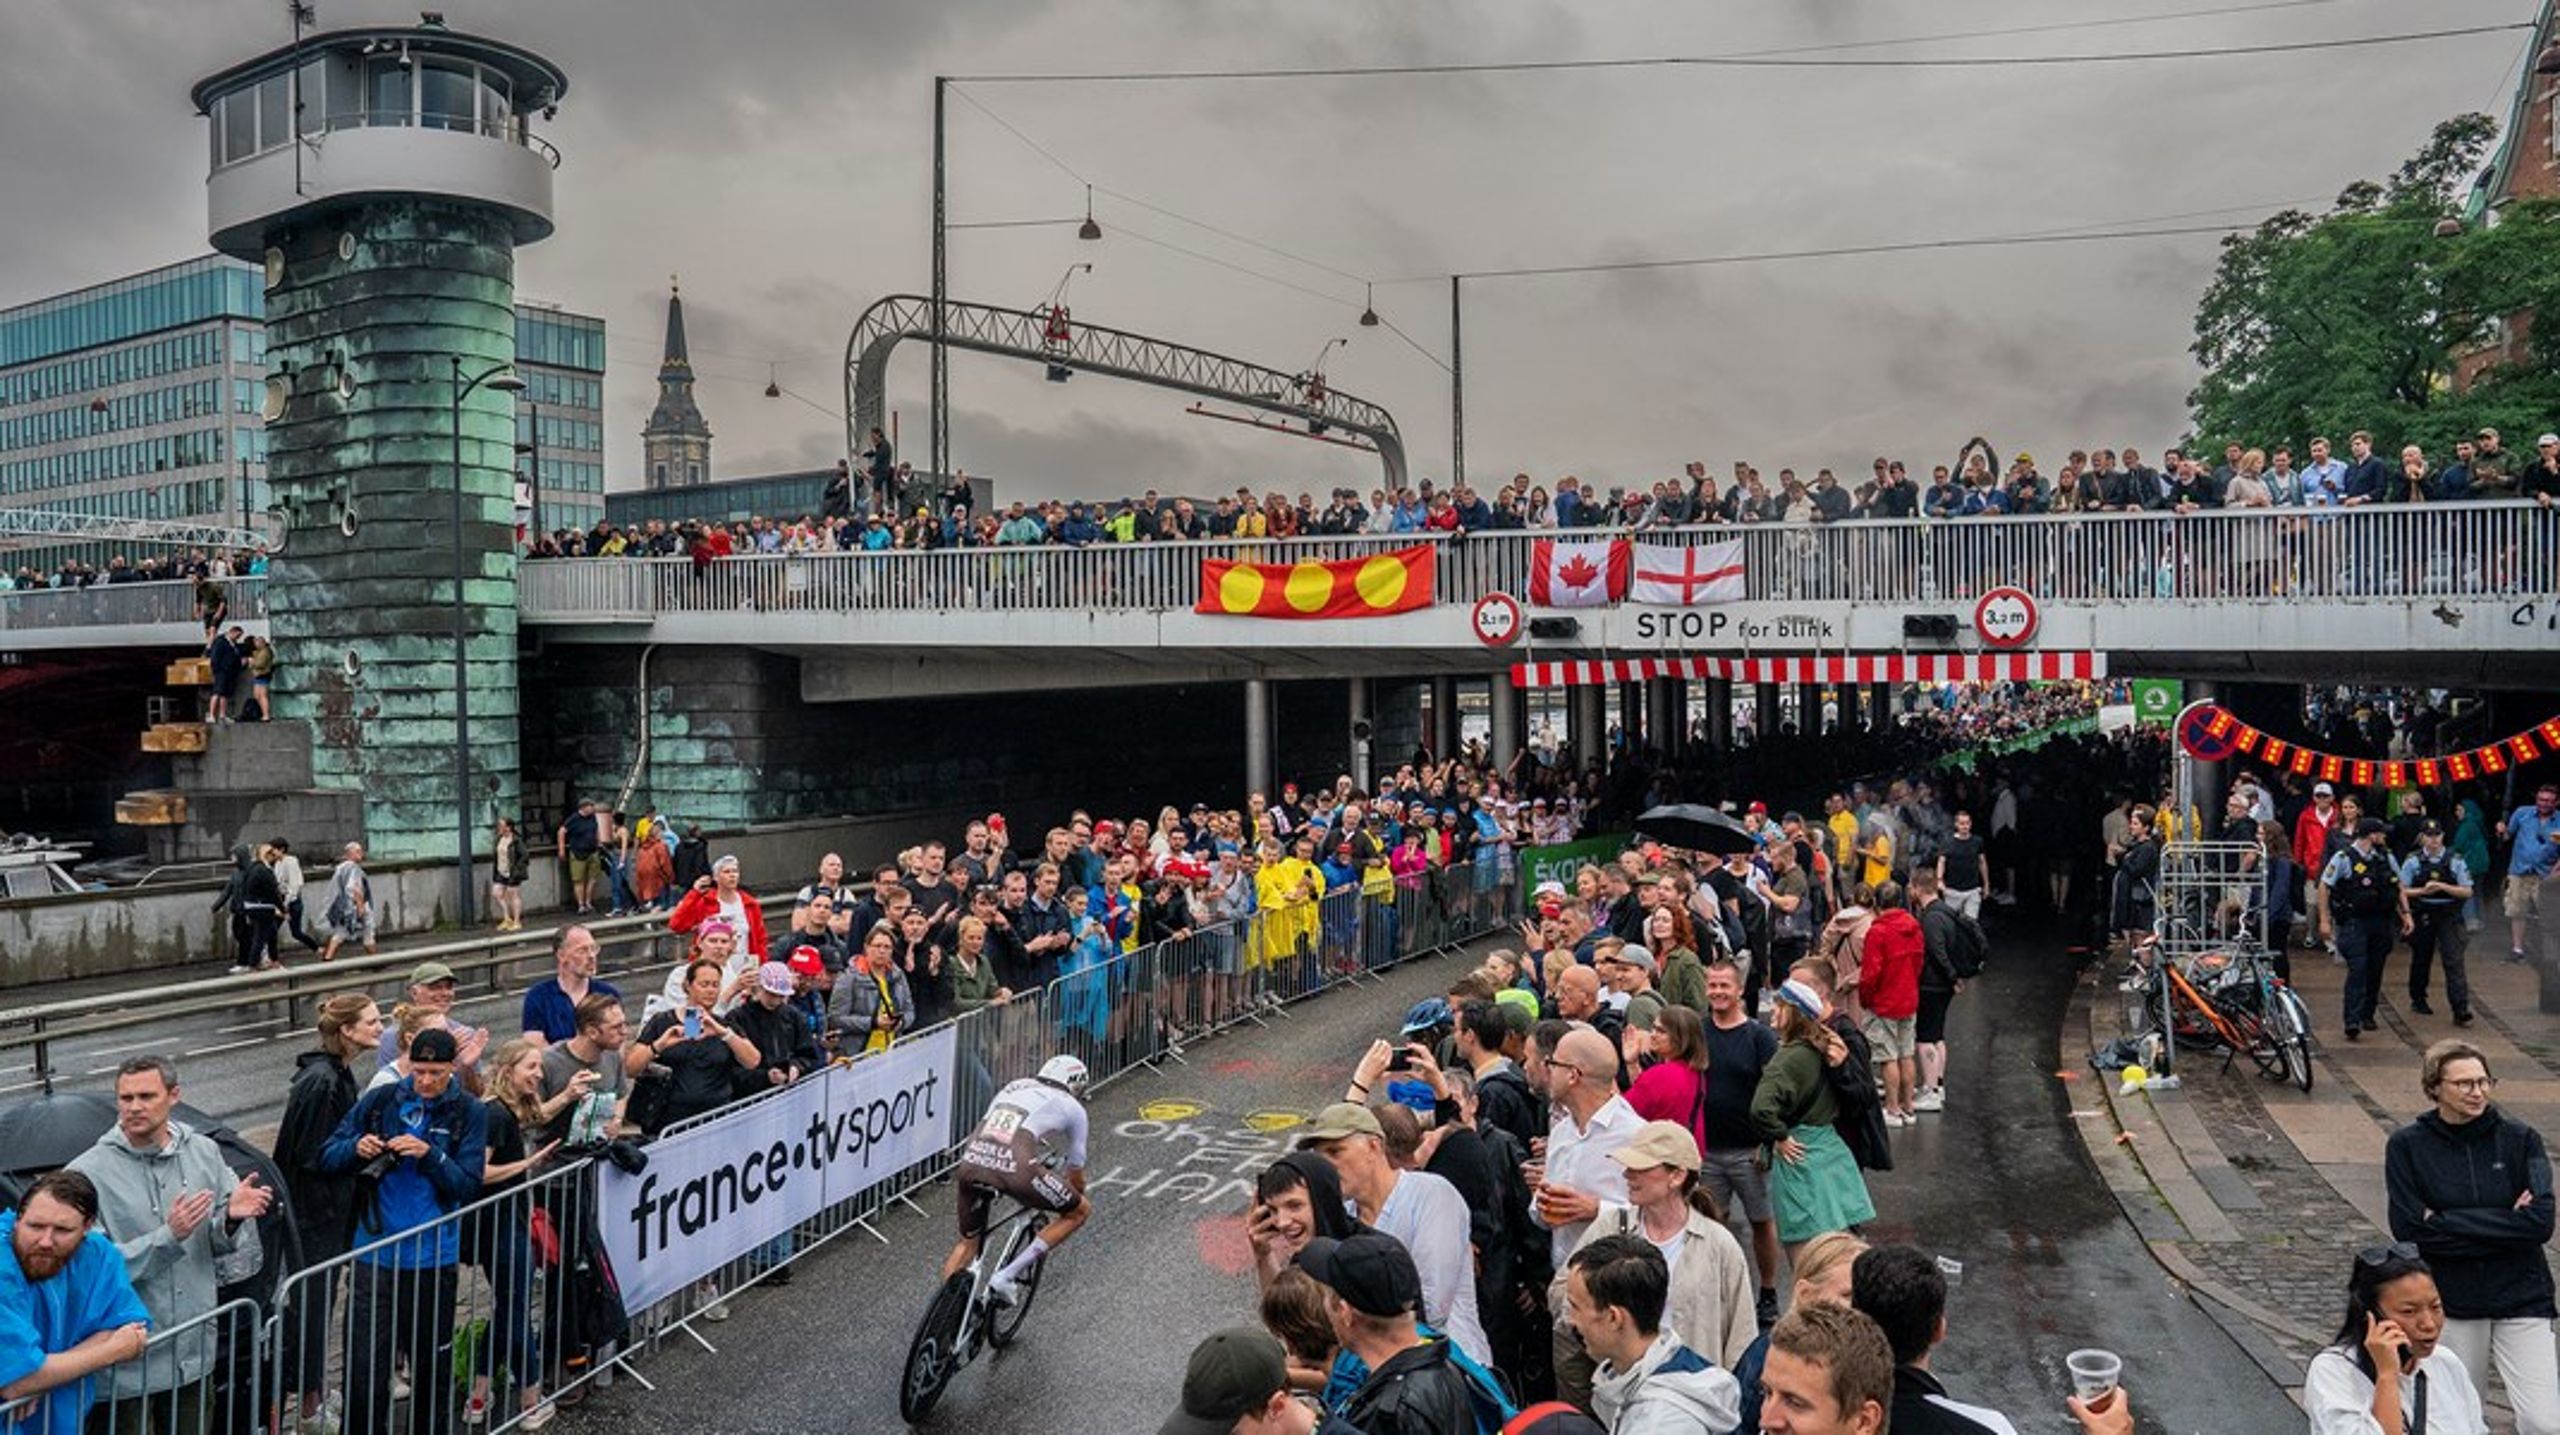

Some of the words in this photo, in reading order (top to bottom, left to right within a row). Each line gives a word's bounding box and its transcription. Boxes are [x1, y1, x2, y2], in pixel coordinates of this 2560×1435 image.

[1638, 612, 1728, 638] STOP
[1738, 621, 1770, 637] for
[1778, 620, 1833, 637] blink
